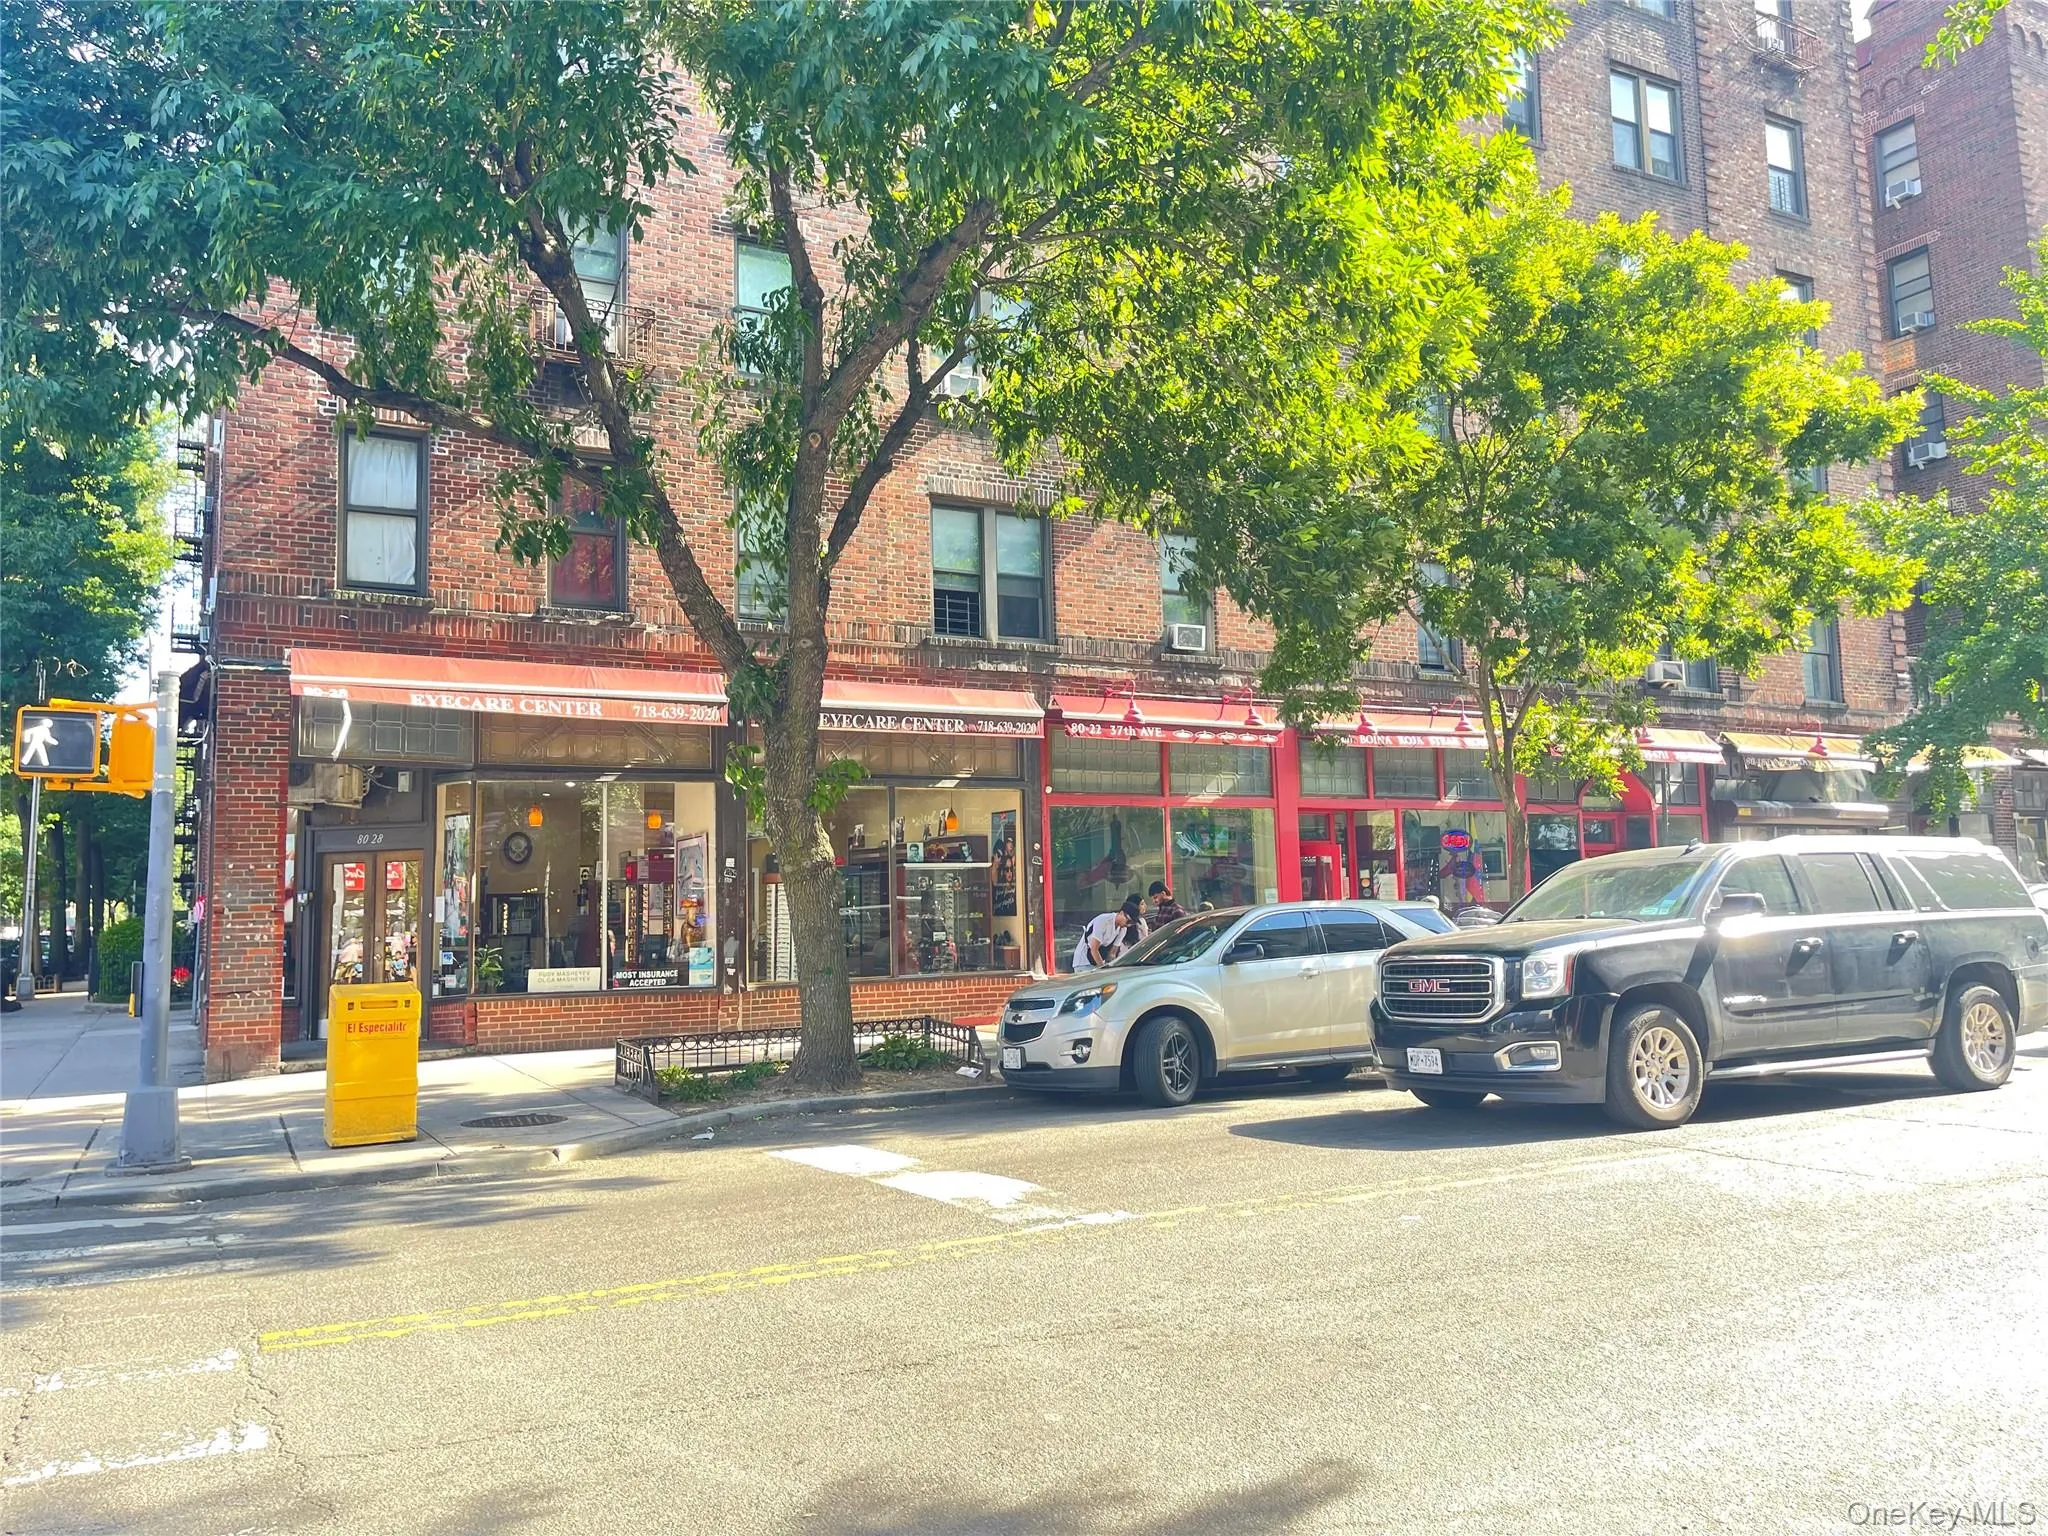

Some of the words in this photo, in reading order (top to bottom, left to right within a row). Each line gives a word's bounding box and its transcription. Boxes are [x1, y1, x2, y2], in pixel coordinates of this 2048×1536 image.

[409, 693, 514, 712] EYECARE
[519, 699, 603, 718] CENTER
[632, 705, 720, 722] 718-639-2020
[819, 713, 898, 730] EYECARE
[901, 717, 965, 733] CENTER
[977, 720, 1037, 735] 718-639-2020
[1110, 725, 1138, 738] 37th
[357, 834, 369, 845] 80
[371, 833, 384, 844] 28
[615, 971, 637, 979] MOST
[638, 969, 679, 978] INSURANCE
[629, 978, 667, 987] ACCEPTED
[1408, 979, 1450, 993] GMC
